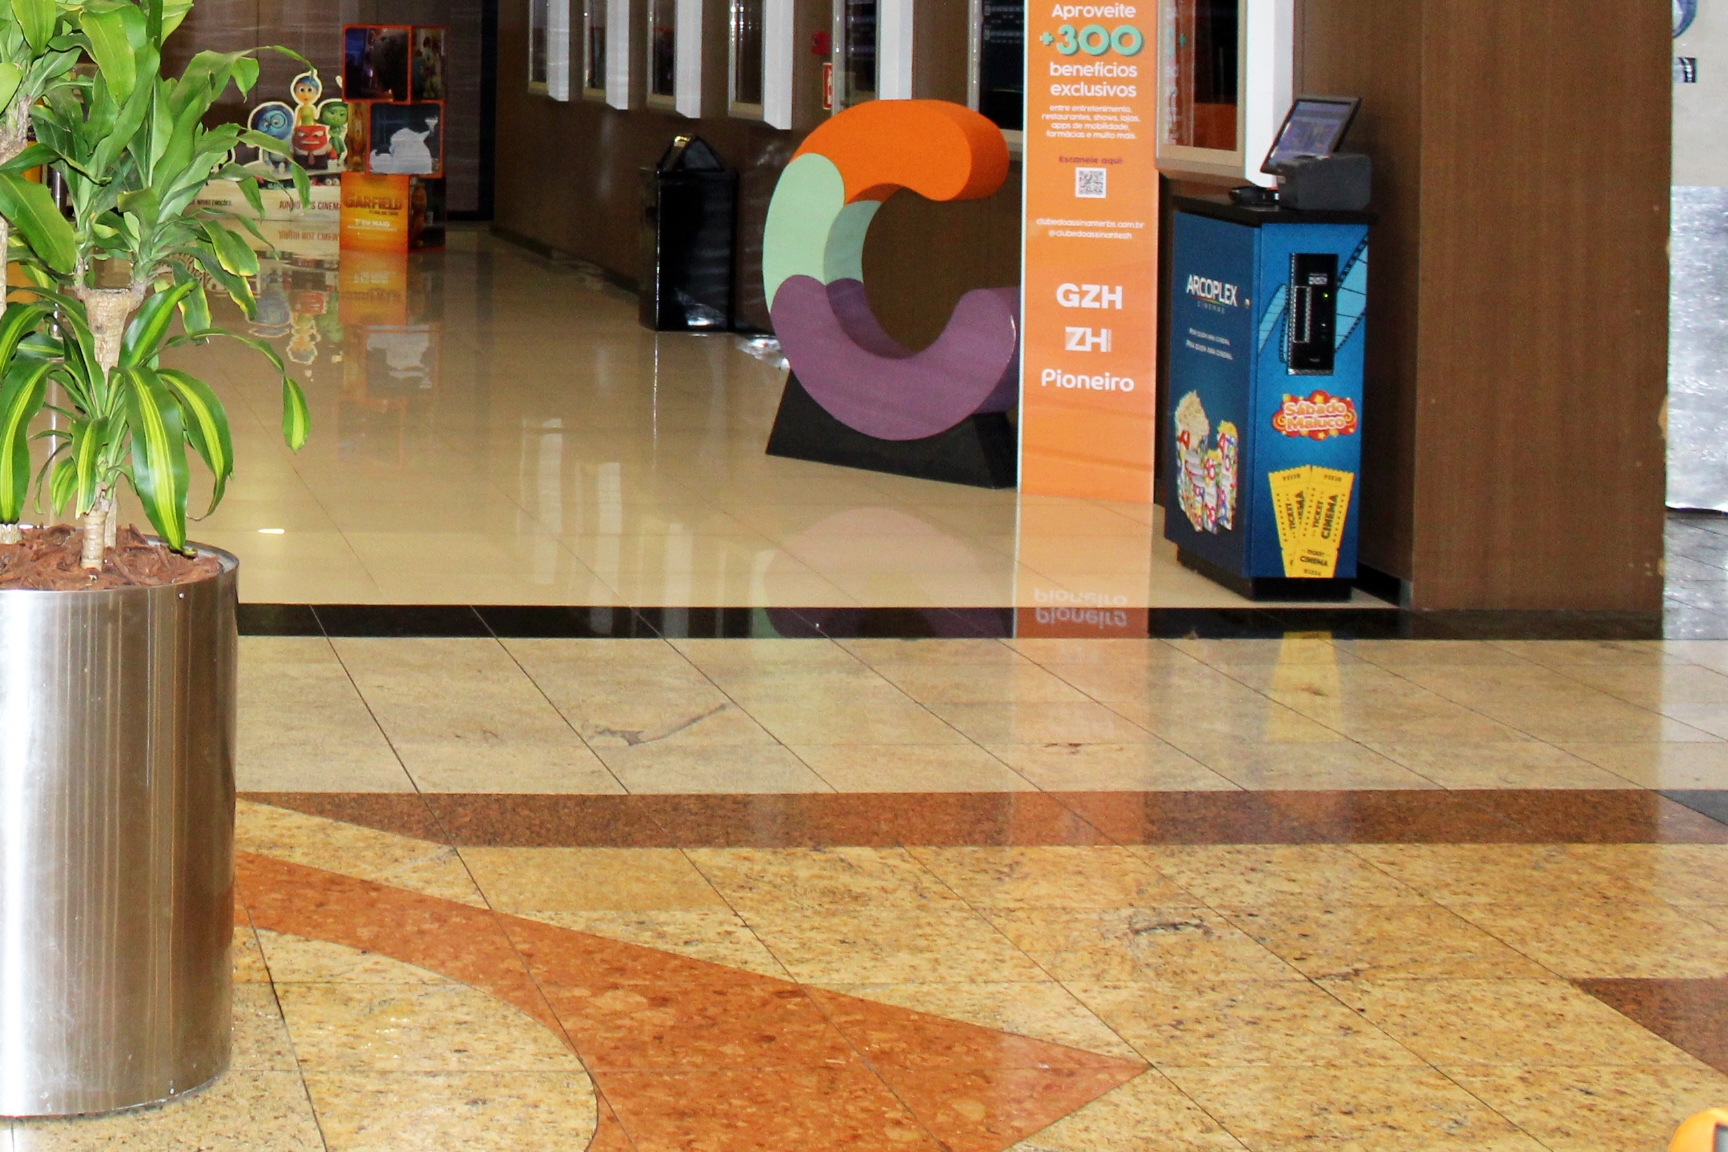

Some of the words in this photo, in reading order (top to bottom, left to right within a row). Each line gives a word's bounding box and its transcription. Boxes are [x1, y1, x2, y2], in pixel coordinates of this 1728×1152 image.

[1051, 2, 1136, 20] Aproveite
[1039, 24, 1145, 56] +300
[1049, 61, 1138, 77] benefícios
[1049, 81, 1137, 97] exclusivos
[1046, 130, 1085, 138] farmácias
[1051, 122, 1071, 130] apps
[1058, 156, 1098, 164] Escaneie
[279, 201, 300, 210] JUNO
[318, 202, 340, 210] CINEM
[1056, 282, 1123, 310] GZH
[1186, 274, 1238, 308] ARCOPLEX
[1065, 326, 1108, 352] ZH
[1041, 368, 1135, 392] Pioneiro
[1283, 400, 1347, 416] Sábado
[1285, 415, 1347, 432] Maluco
[1285, 502, 1296, 530] TICKET
[1312, 500, 1324, 529] TICKET
[1321, 494, 1339, 540] CINEMA
[1300, 556, 1328, 566] CINEMA
